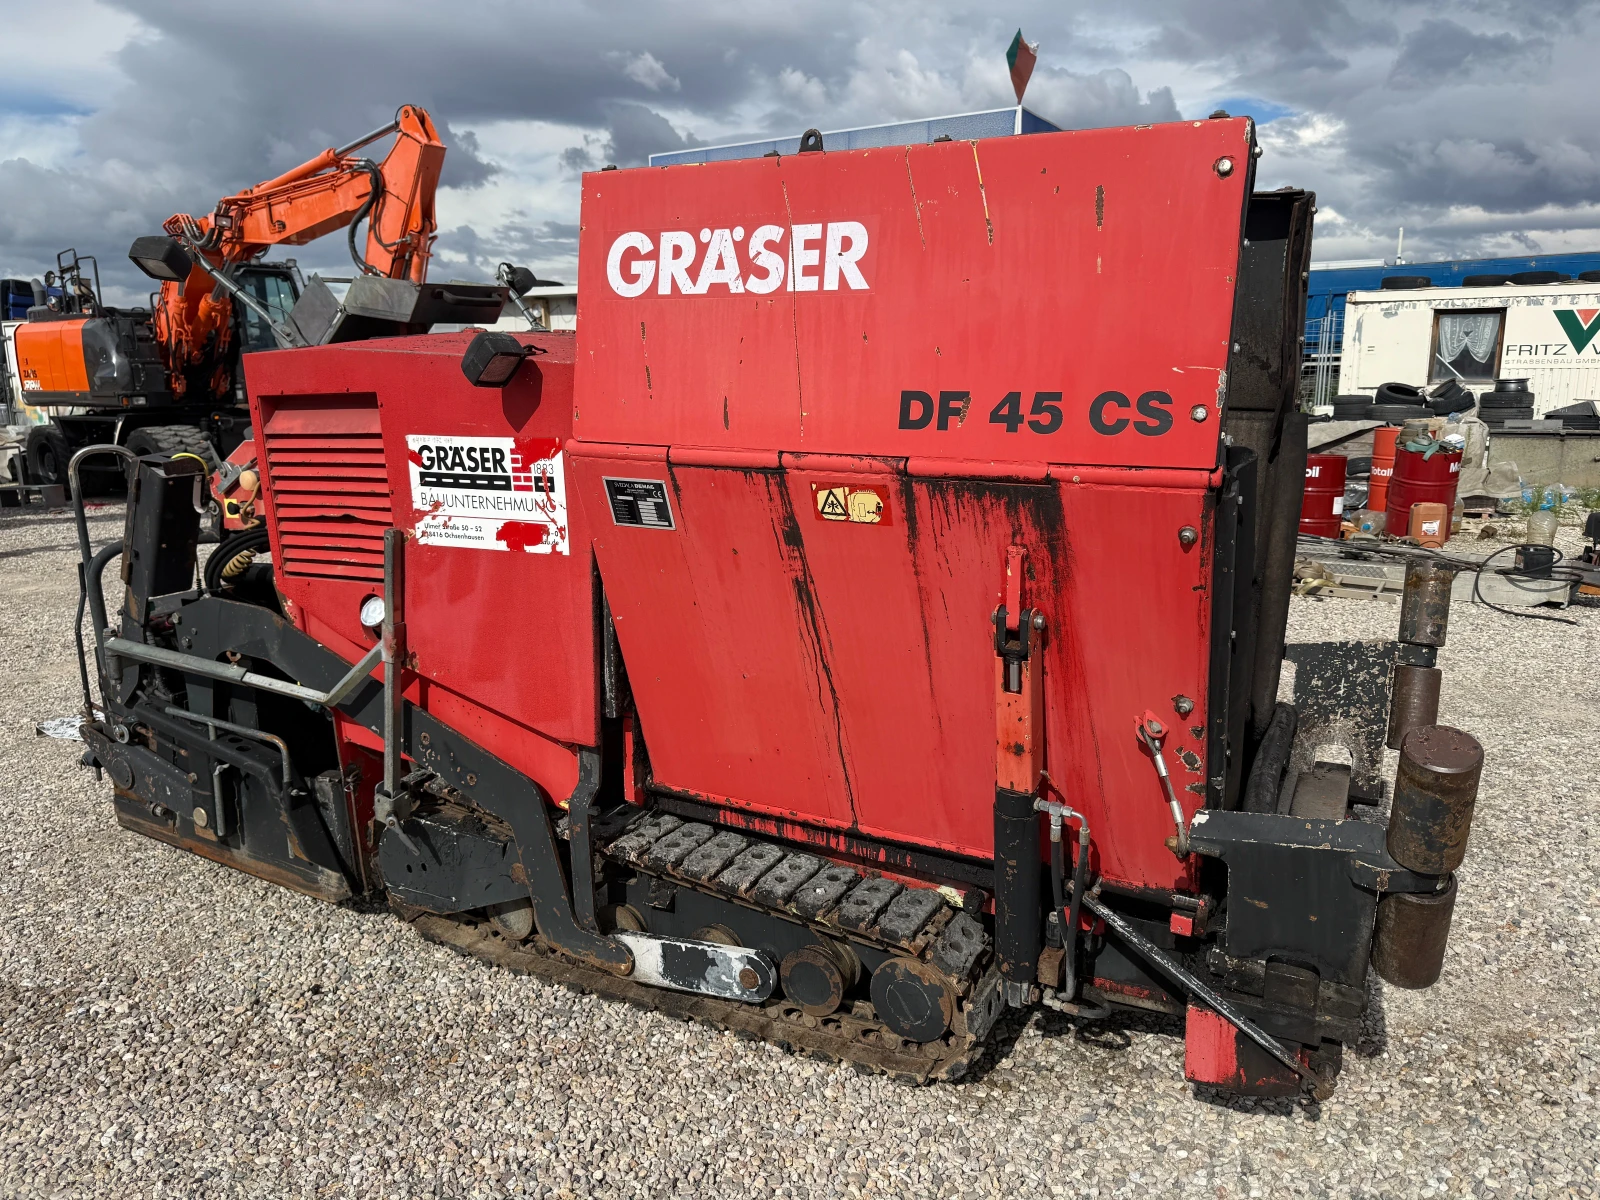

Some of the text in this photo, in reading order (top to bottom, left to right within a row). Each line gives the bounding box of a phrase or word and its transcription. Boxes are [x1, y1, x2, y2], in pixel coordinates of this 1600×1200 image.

[606, 221, 870, 297] GRÄSER
[1505, 343, 1568, 356] FRITZ
[898, 390, 1174, 436] DF 45 CS
[418, 445, 508, 473] GRÄSER
[533, 463, 554, 475] 1883
[420, 492, 556, 512] BAUUNTERNEHMUNG
[421, 530, 485, 541] 8416 Ochsenhausen
